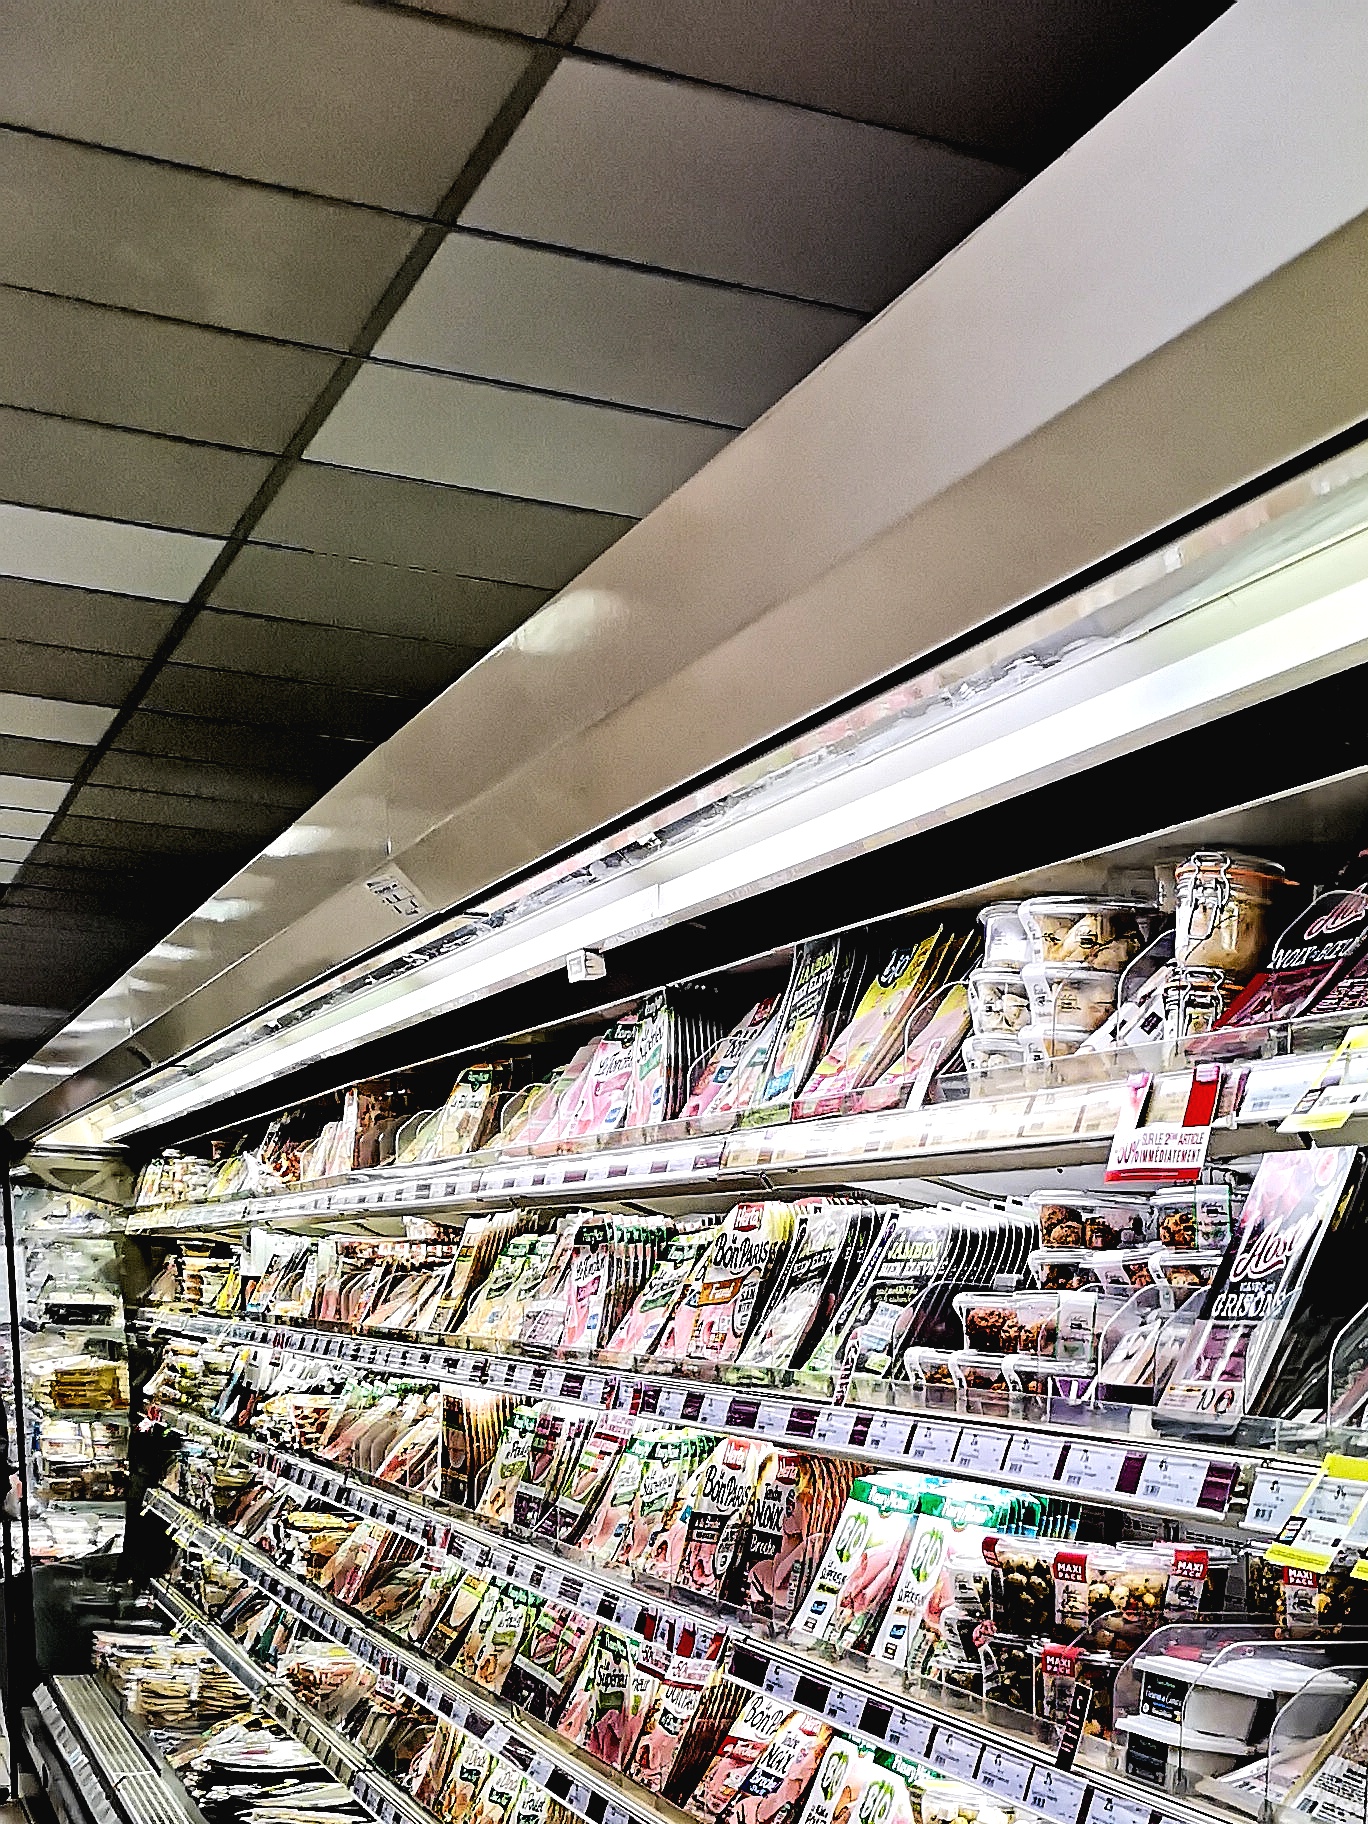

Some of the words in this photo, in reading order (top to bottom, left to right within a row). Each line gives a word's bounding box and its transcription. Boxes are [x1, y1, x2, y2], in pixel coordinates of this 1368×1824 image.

[1057, 1563, 1082, 1573] MAXI
[1177, 1561, 1205, 1571] MAXI
[1288, 1569, 1313, 1579] MAXI
[1046, 1656, 1072, 1667] MAXI
